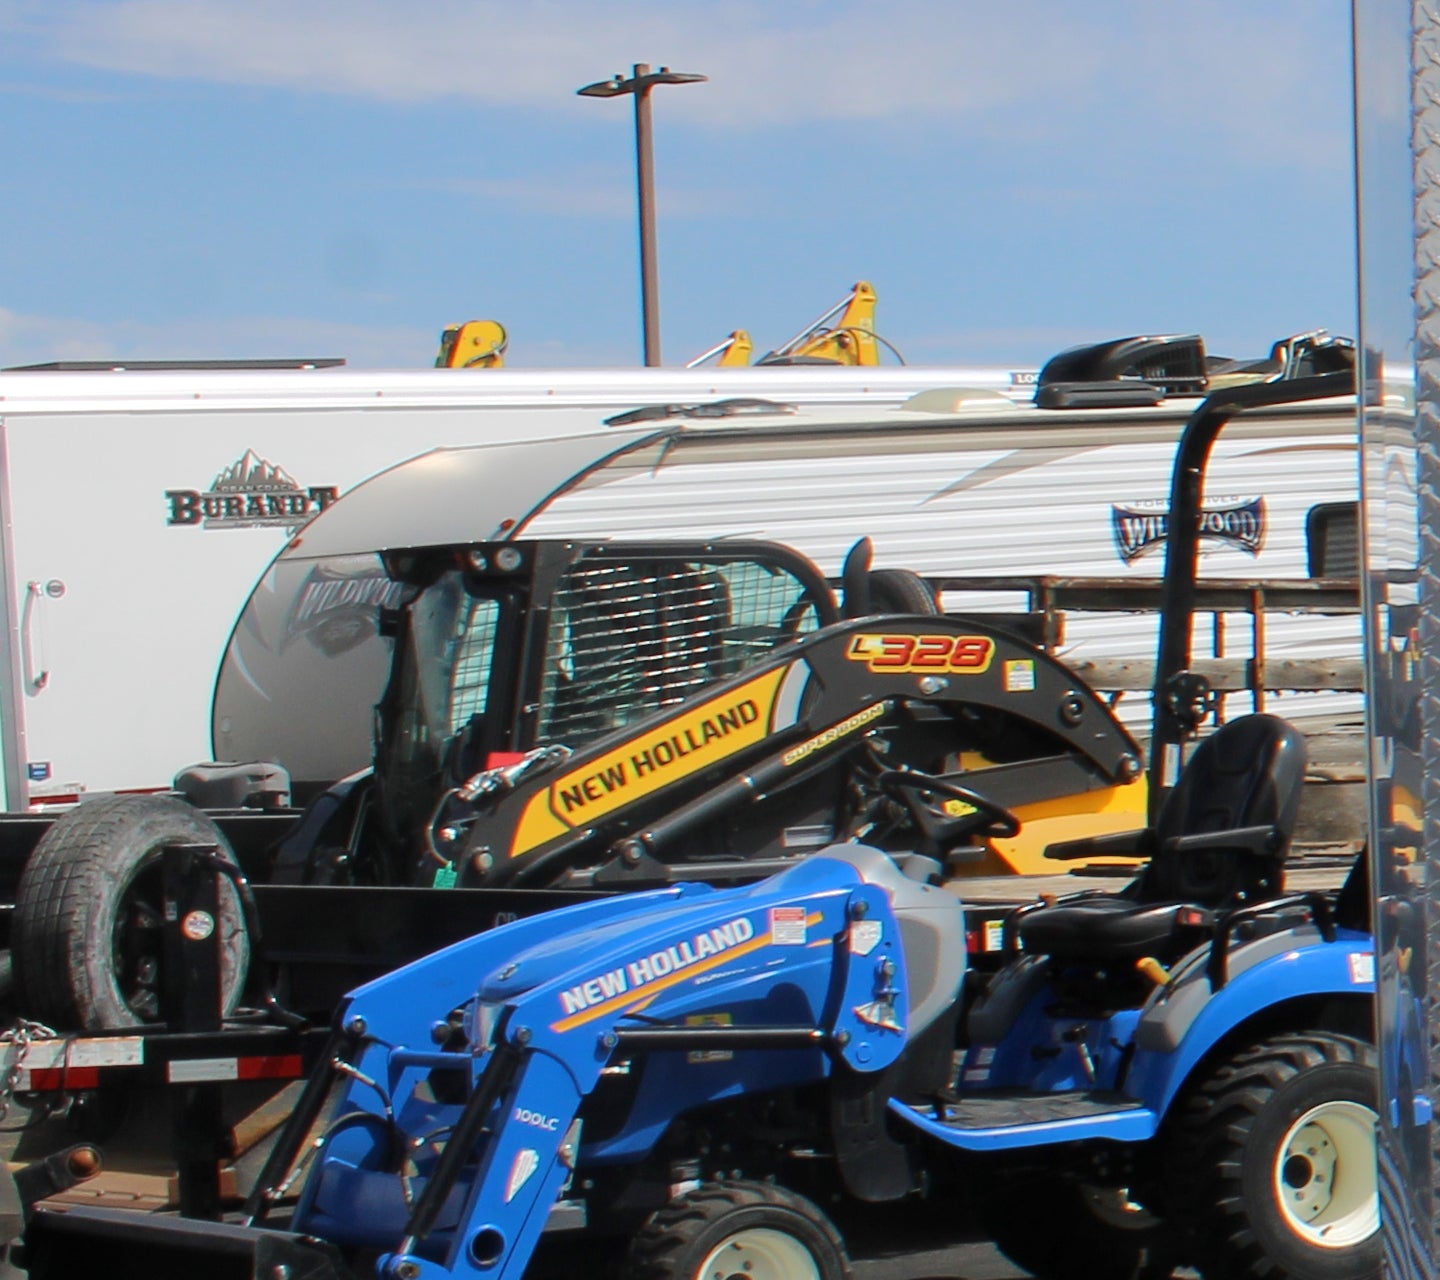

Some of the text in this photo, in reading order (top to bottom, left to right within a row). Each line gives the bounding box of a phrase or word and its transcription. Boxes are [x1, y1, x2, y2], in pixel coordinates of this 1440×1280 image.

[166, 486, 338, 525] BURANDT
[559, 699, 760, 813] NEW HOLLAND
[560, 967, 629, 1015] NEW
[628, 916, 756, 987] HOLLAND
